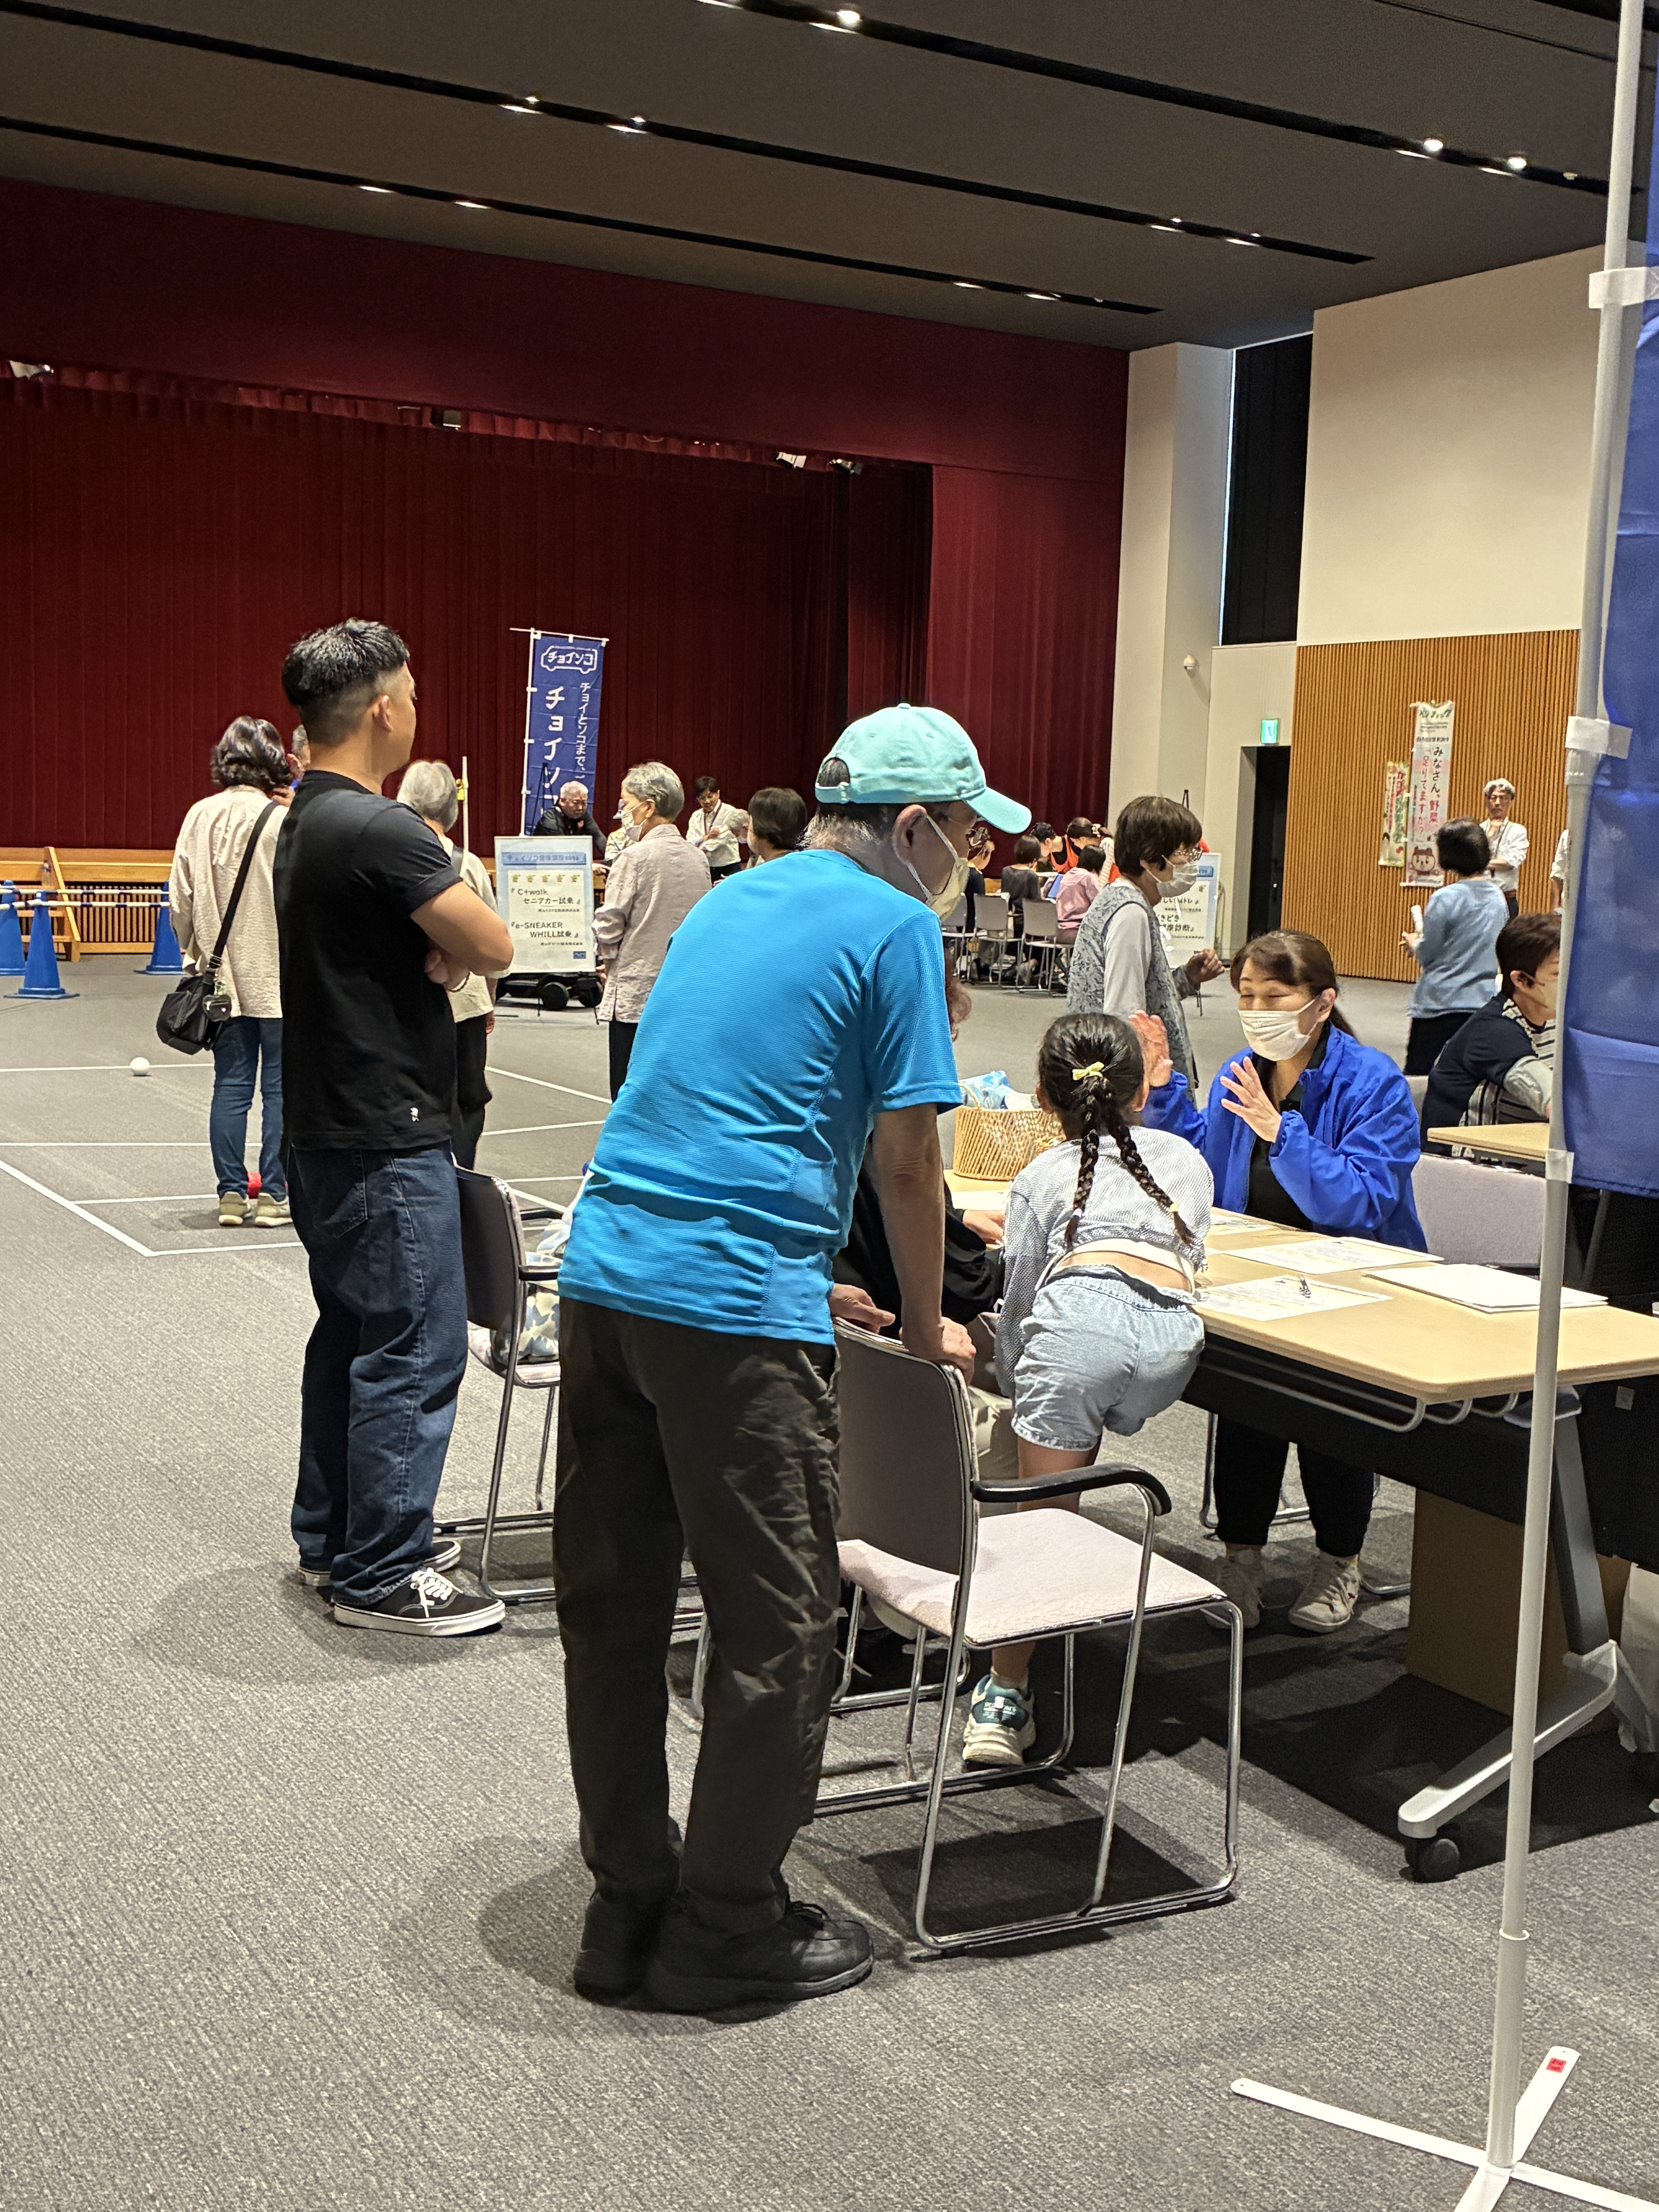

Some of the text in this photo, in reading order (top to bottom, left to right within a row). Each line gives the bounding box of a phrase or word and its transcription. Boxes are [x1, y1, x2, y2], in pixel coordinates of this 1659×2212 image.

[547, 651, 593, 665] チョイソコ
